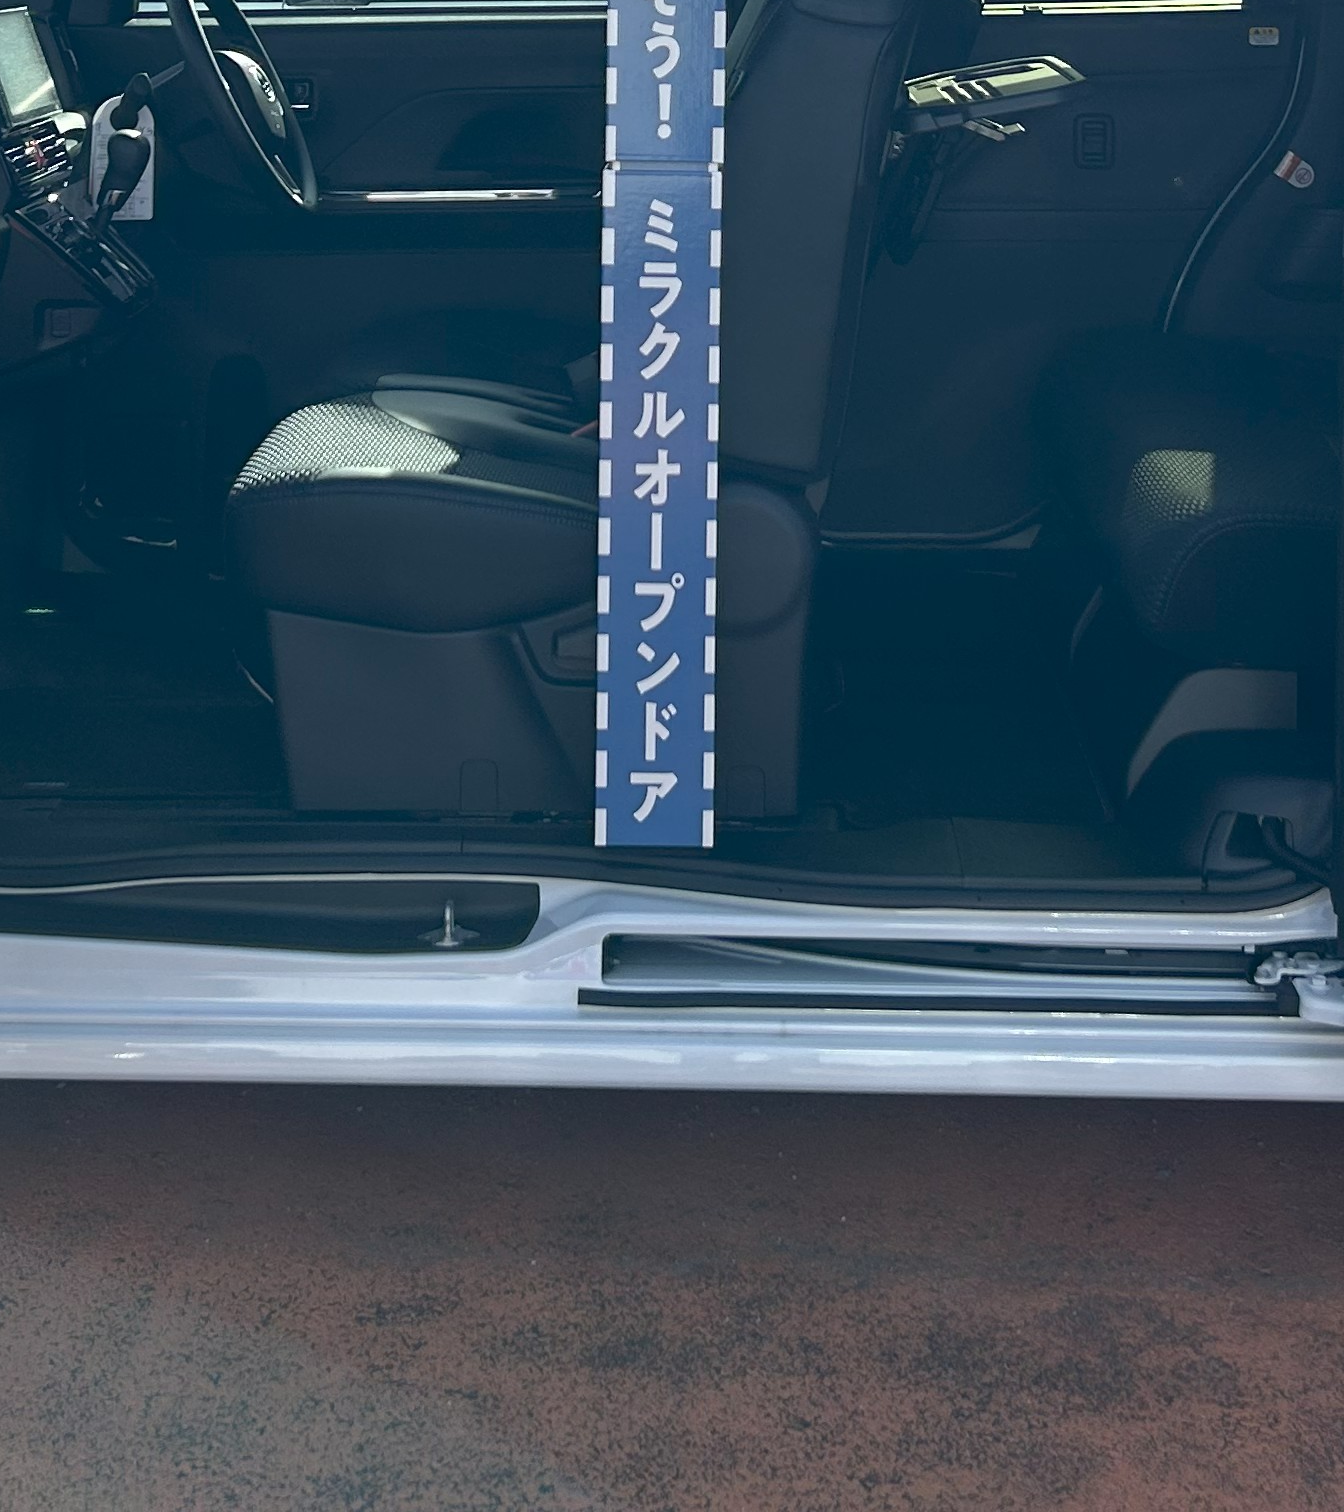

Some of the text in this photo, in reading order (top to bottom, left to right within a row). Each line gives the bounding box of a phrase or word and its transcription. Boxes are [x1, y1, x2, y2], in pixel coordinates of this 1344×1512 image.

[629, 198, 686, 823] ミラクルオープンドア
